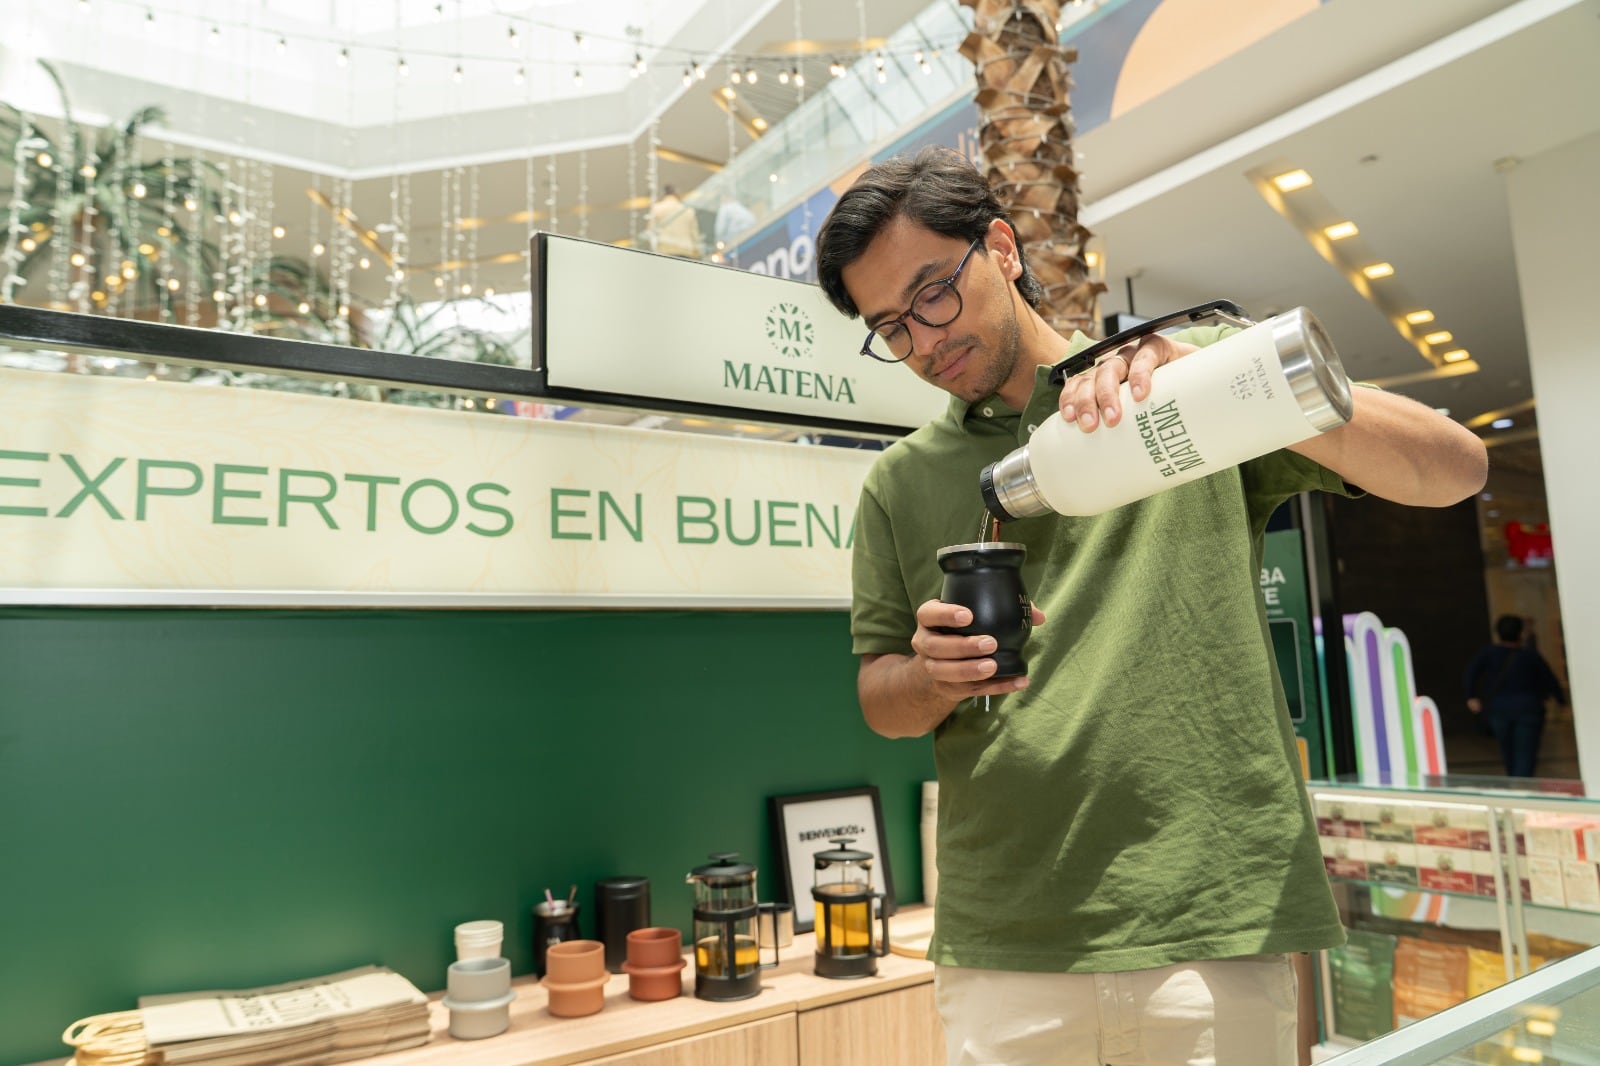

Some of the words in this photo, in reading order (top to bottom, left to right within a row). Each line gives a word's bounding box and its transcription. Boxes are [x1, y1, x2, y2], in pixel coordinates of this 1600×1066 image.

[723, 359, 856, 404] MATENA
[1136, 410, 1166, 464] PARCHE
[1151, 399, 1206, 472] MATENA
[1160, 463, 1176, 477] EL
[0, 450, 513, 538] EXPERTOS
[550, 487, 643, 542] EN
[676, 495, 860, 549] BUEN
